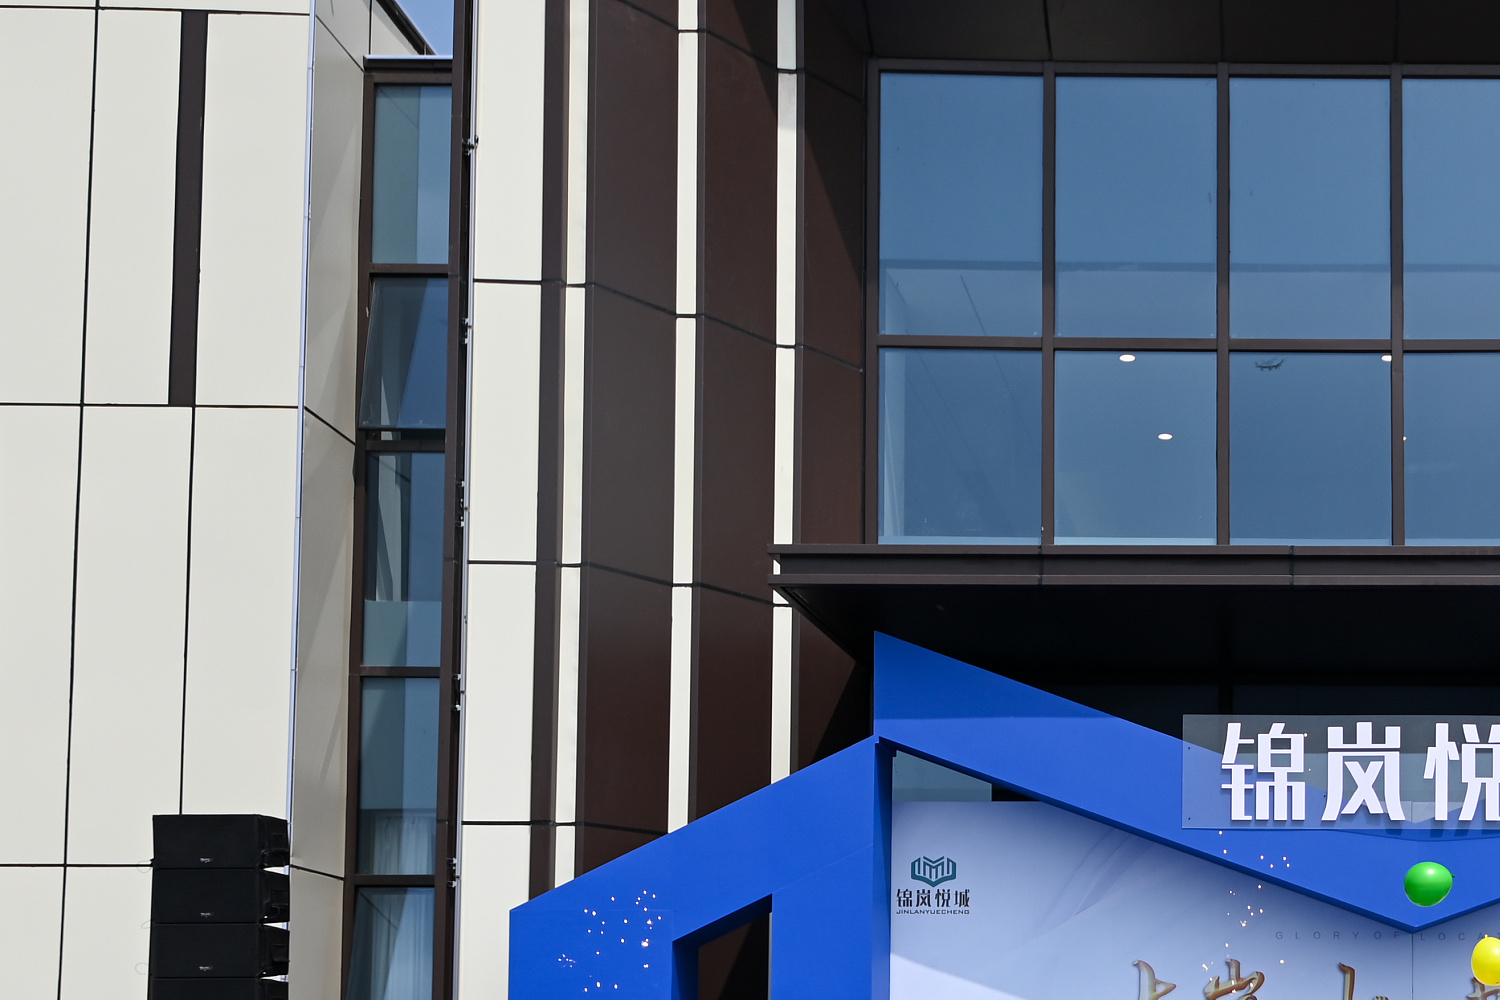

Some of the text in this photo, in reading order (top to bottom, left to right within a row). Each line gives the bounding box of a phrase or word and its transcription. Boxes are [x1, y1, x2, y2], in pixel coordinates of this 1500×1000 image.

[896, 888, 970, 907] 锦岚悦城
[1275, 931, 1360, 940] GLORY
[1374, 930, 1400, 940] OF
